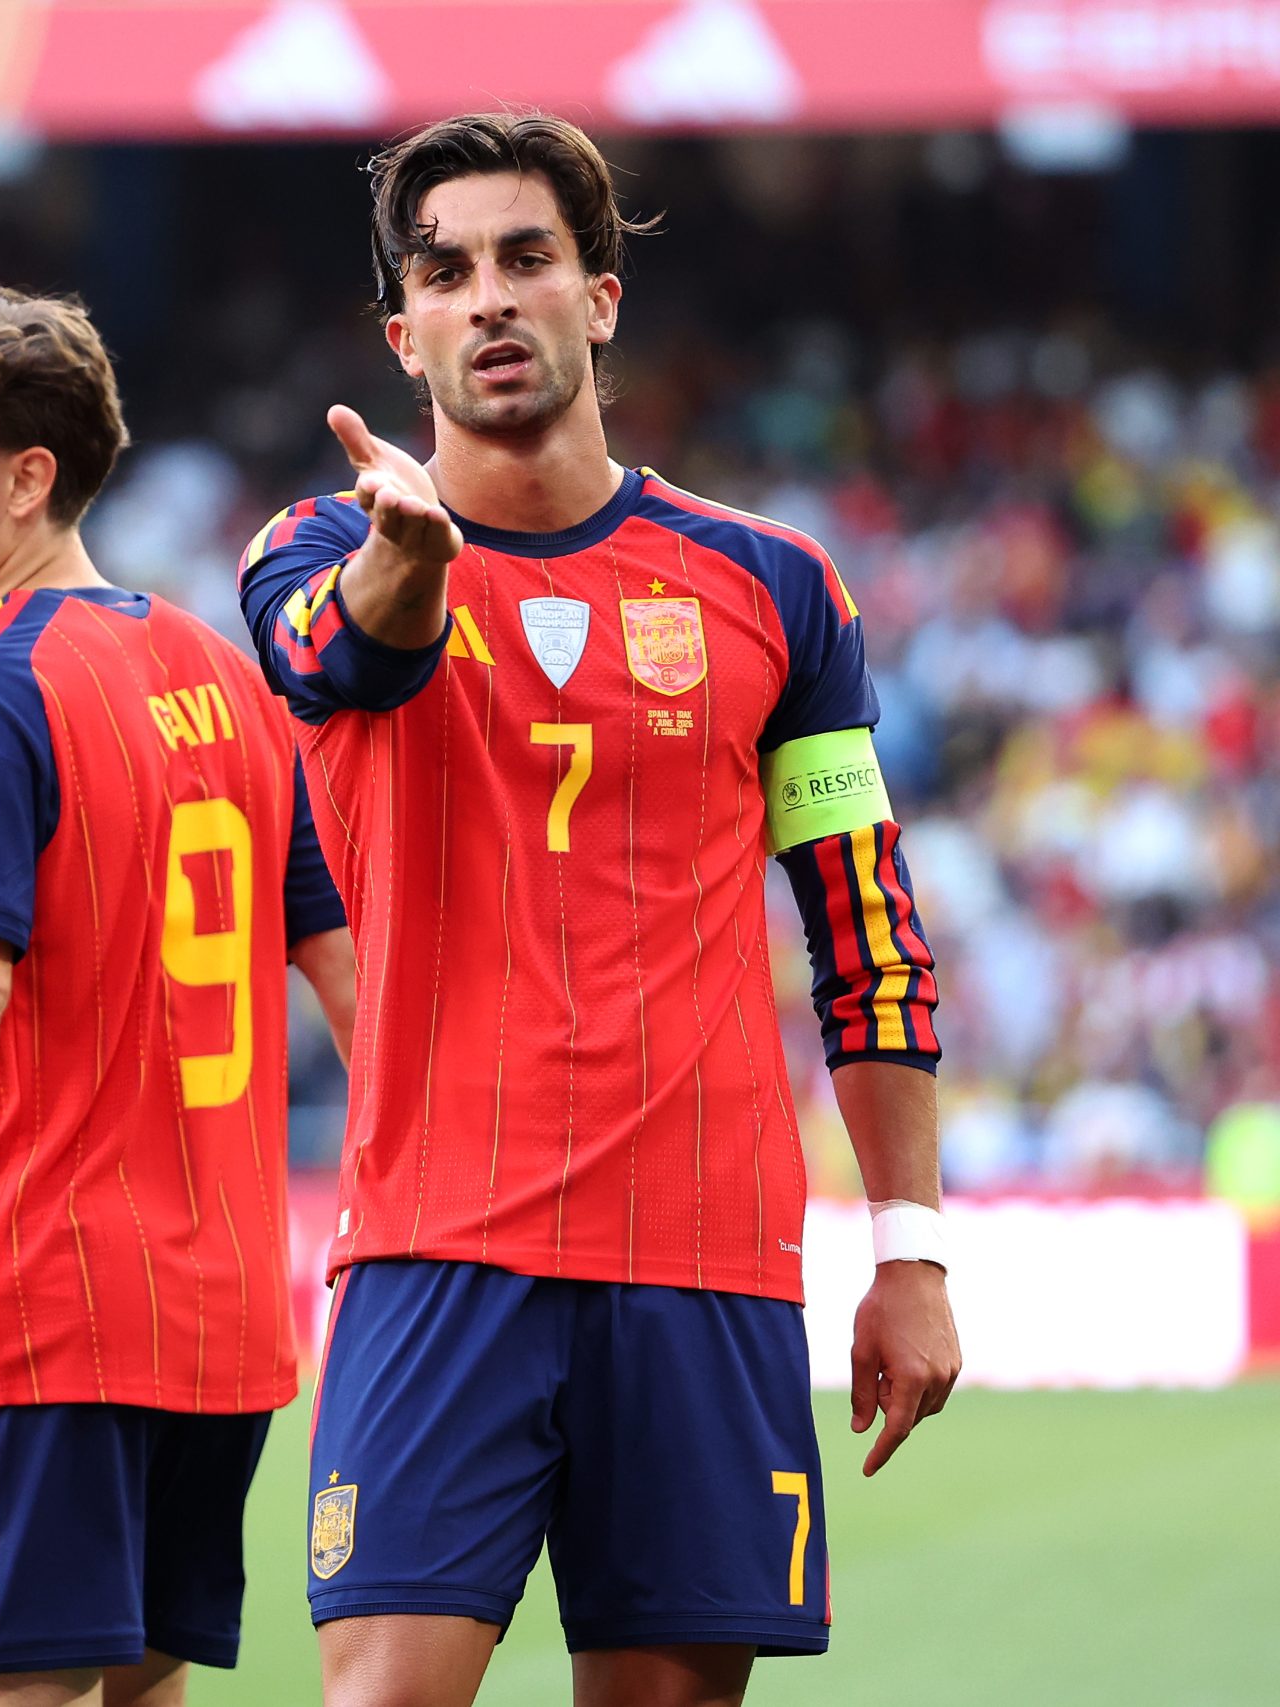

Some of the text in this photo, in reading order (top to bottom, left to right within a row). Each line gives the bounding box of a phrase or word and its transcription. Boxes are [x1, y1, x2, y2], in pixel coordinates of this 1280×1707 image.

[527, 609, 583, 619] EUROPEAN
[528, 618, 583, 628] CHAMPIONS
[148, 684, 235, 751] GAVI
[646, 718, 653, 726] 4
[656, 718, 674, 726] JUNE
[647, 709, 669, 718] SPAIN
[653, 727, 658, 736] A
[530, 722, 593, 852] 7
[809, 768, 878, 797] RESPECT
[161, 798, 253, 1108] 9
[771, 1470, 811, 1606] 7
